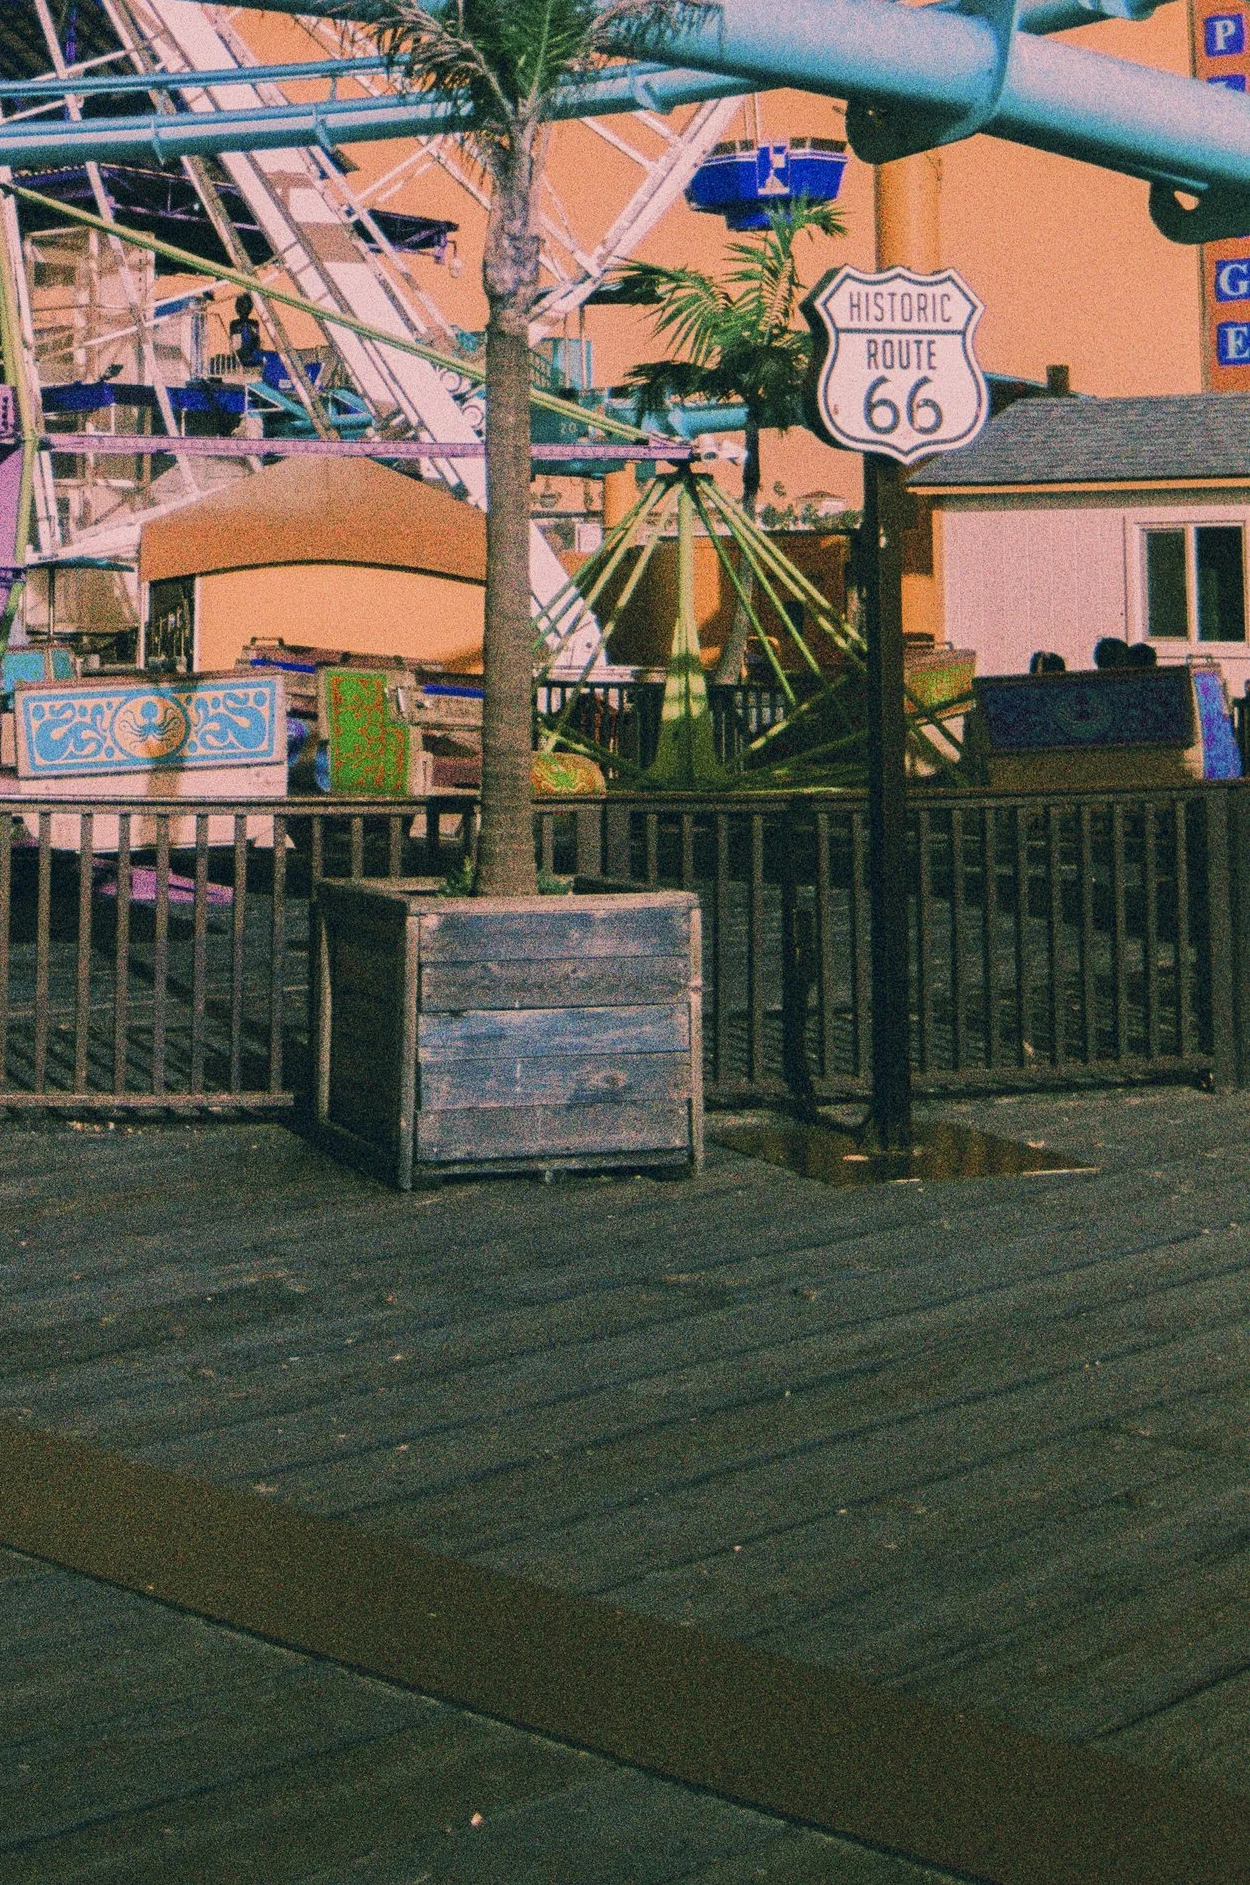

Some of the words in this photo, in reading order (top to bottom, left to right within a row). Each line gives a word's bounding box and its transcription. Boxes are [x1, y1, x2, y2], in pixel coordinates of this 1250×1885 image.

[849, 292, 952, 322] HISTORIC
[866, 339, 937, 370] ROUTE
[864, 376, 943, 434] 66
